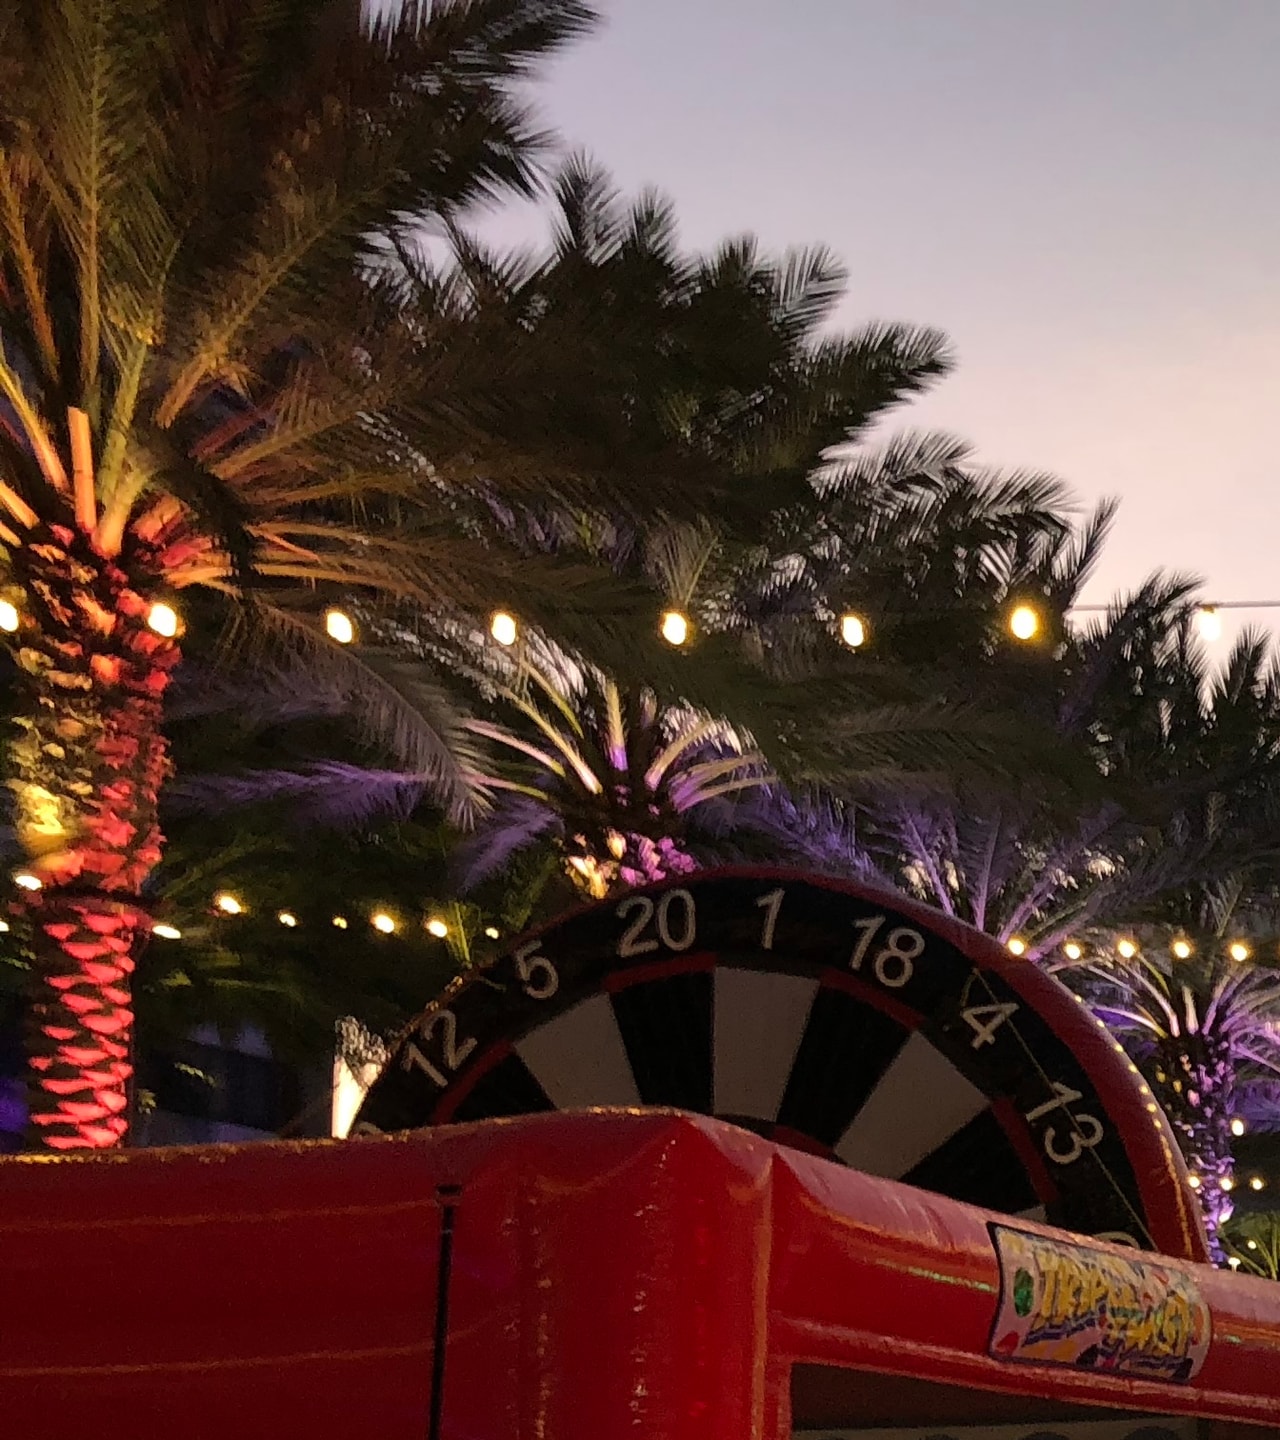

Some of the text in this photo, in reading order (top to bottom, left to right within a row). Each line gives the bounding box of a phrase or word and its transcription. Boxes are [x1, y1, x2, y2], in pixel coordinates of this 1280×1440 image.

[399, 886, 1105, 1166] 12 5 20 1 18 4 13
